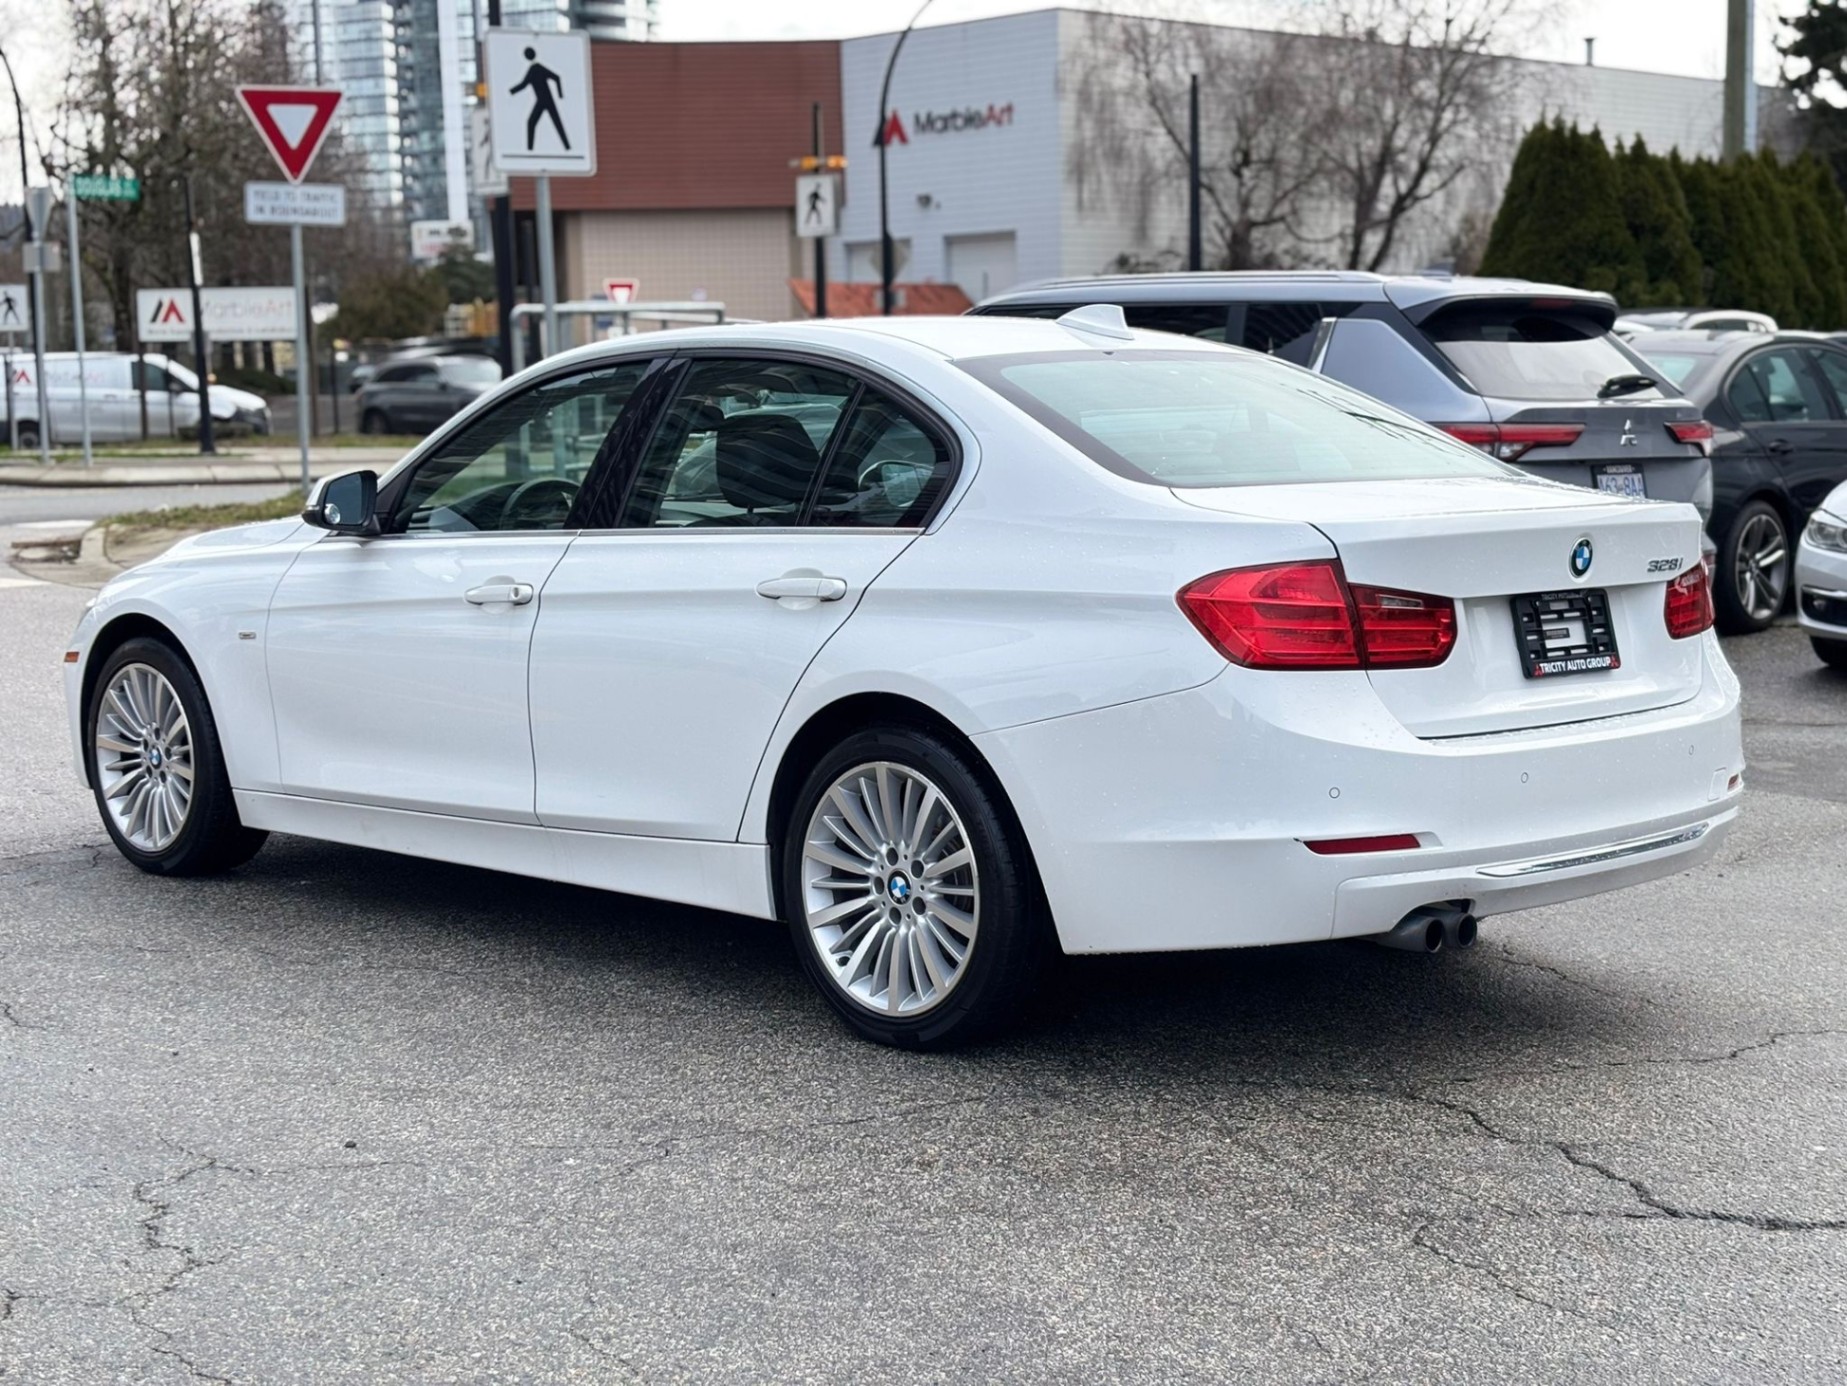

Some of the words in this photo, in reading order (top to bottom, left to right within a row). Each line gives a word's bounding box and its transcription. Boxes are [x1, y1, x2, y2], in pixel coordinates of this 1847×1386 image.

[913, 102, 1014, 134] MarbleArt
[1647, 557, 1684, 572] 328i
[1539, 661, 1566, 674] TRICITY
[1567, 659, 1586, 671] AUTO
[1586, 656, 1612, 669] GROUP
